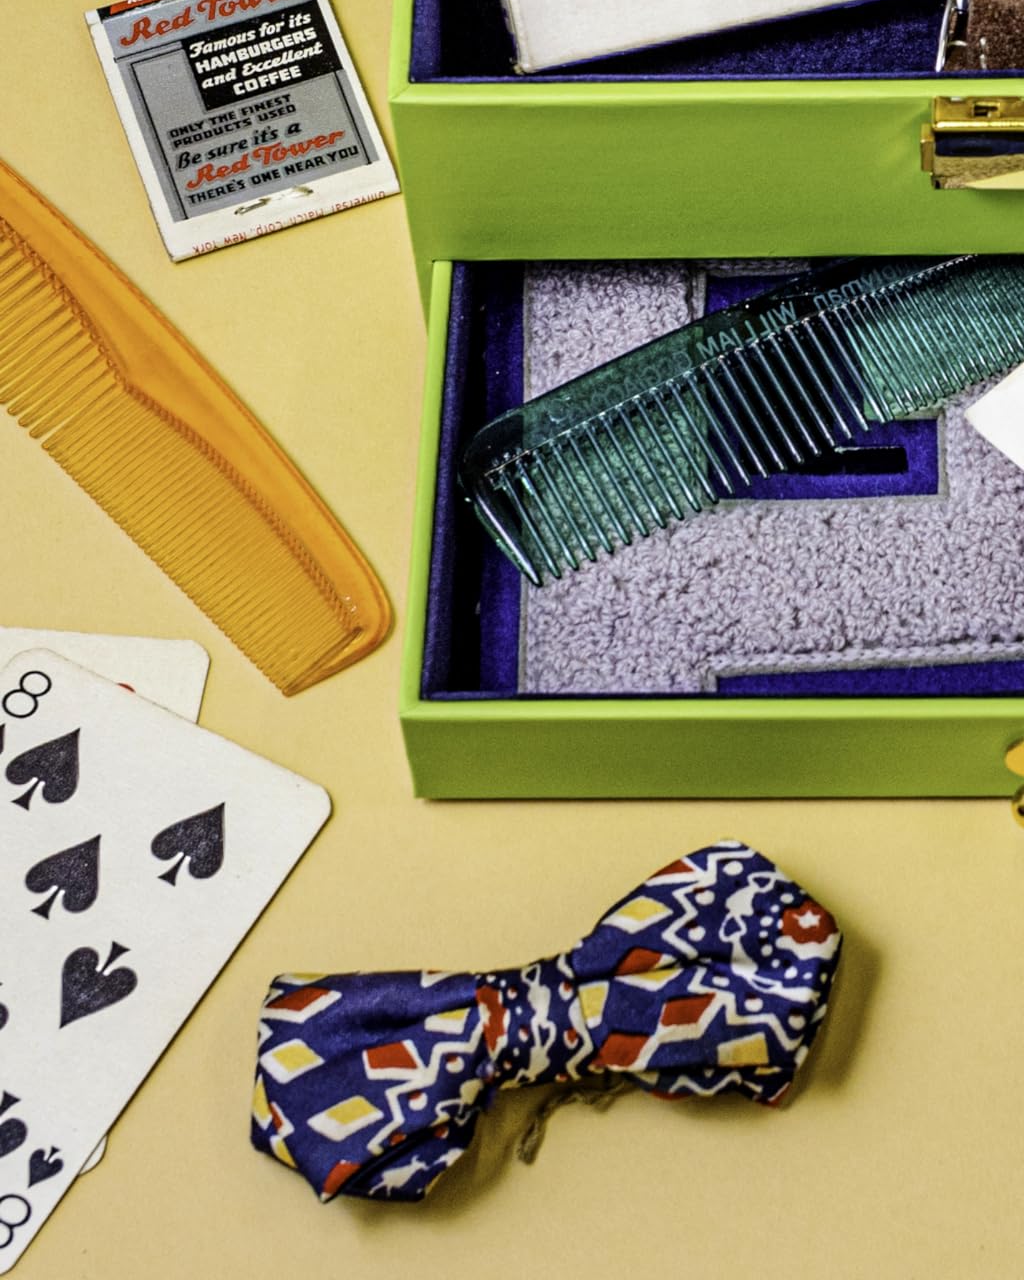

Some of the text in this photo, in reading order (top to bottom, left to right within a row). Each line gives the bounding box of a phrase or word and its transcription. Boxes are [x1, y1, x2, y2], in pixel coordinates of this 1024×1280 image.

[120, 7, 196, 47] Red
[189, 13, 311, 58] Famous for its
[195, 27, 317, 74] HAMBURGERS
[202, 42, 323, 89] and Excellent
[233, 65, 302, 95] COFFEE
[169, 94, 290, 138] ONLY THE FINEST
[171, 104, 296, 149] PRODUCTS USED
[178, 123, 302, 169] Be sure it's a
[186, 130, 344, 190] Red Tower
[188, 145, 359, 204] THERE'S ONE NEAR YOU
[2, 670, 53, 719] 8
